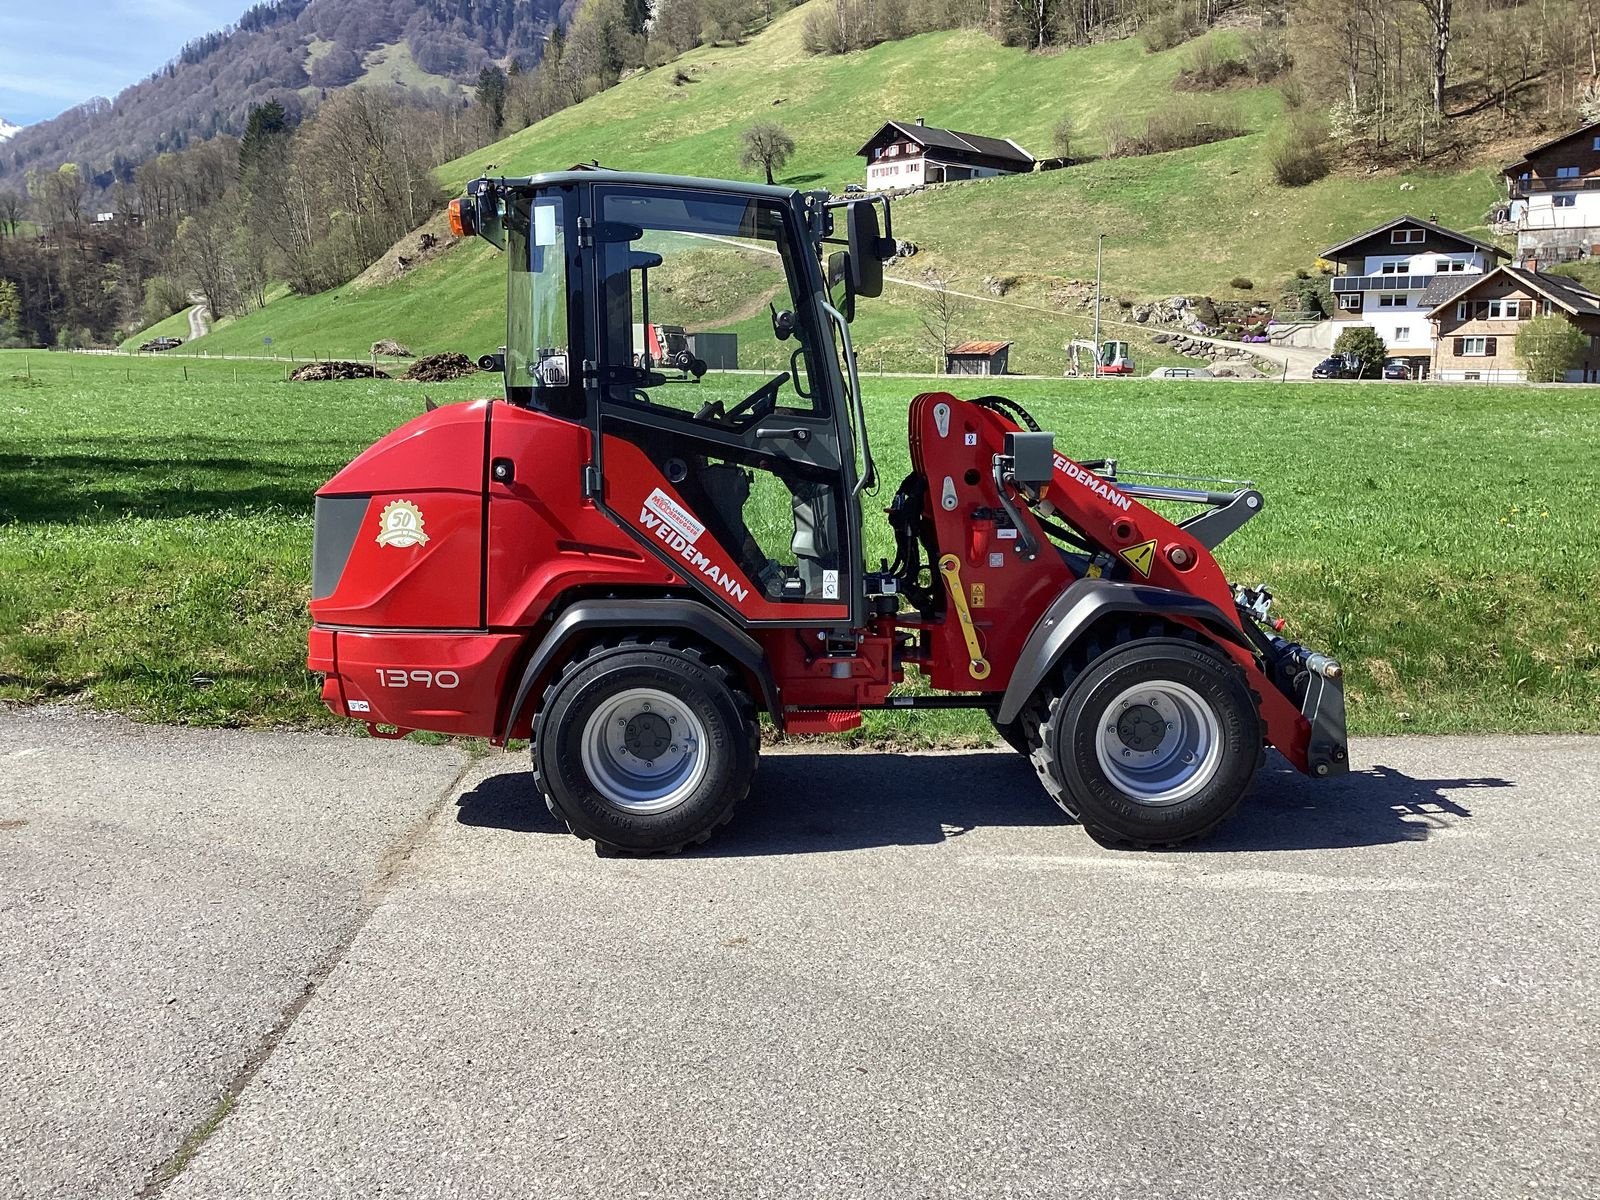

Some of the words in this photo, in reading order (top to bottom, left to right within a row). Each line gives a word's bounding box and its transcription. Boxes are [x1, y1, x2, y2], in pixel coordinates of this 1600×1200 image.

[545, 368, 560, 382] 100
[1053, 453, 1132, 511] EIDEMANN
[392, 511, 412, 528] 50
[640, 507, 749, 602] WEIDEMANN
[375, 668, 460, 689] 1390
